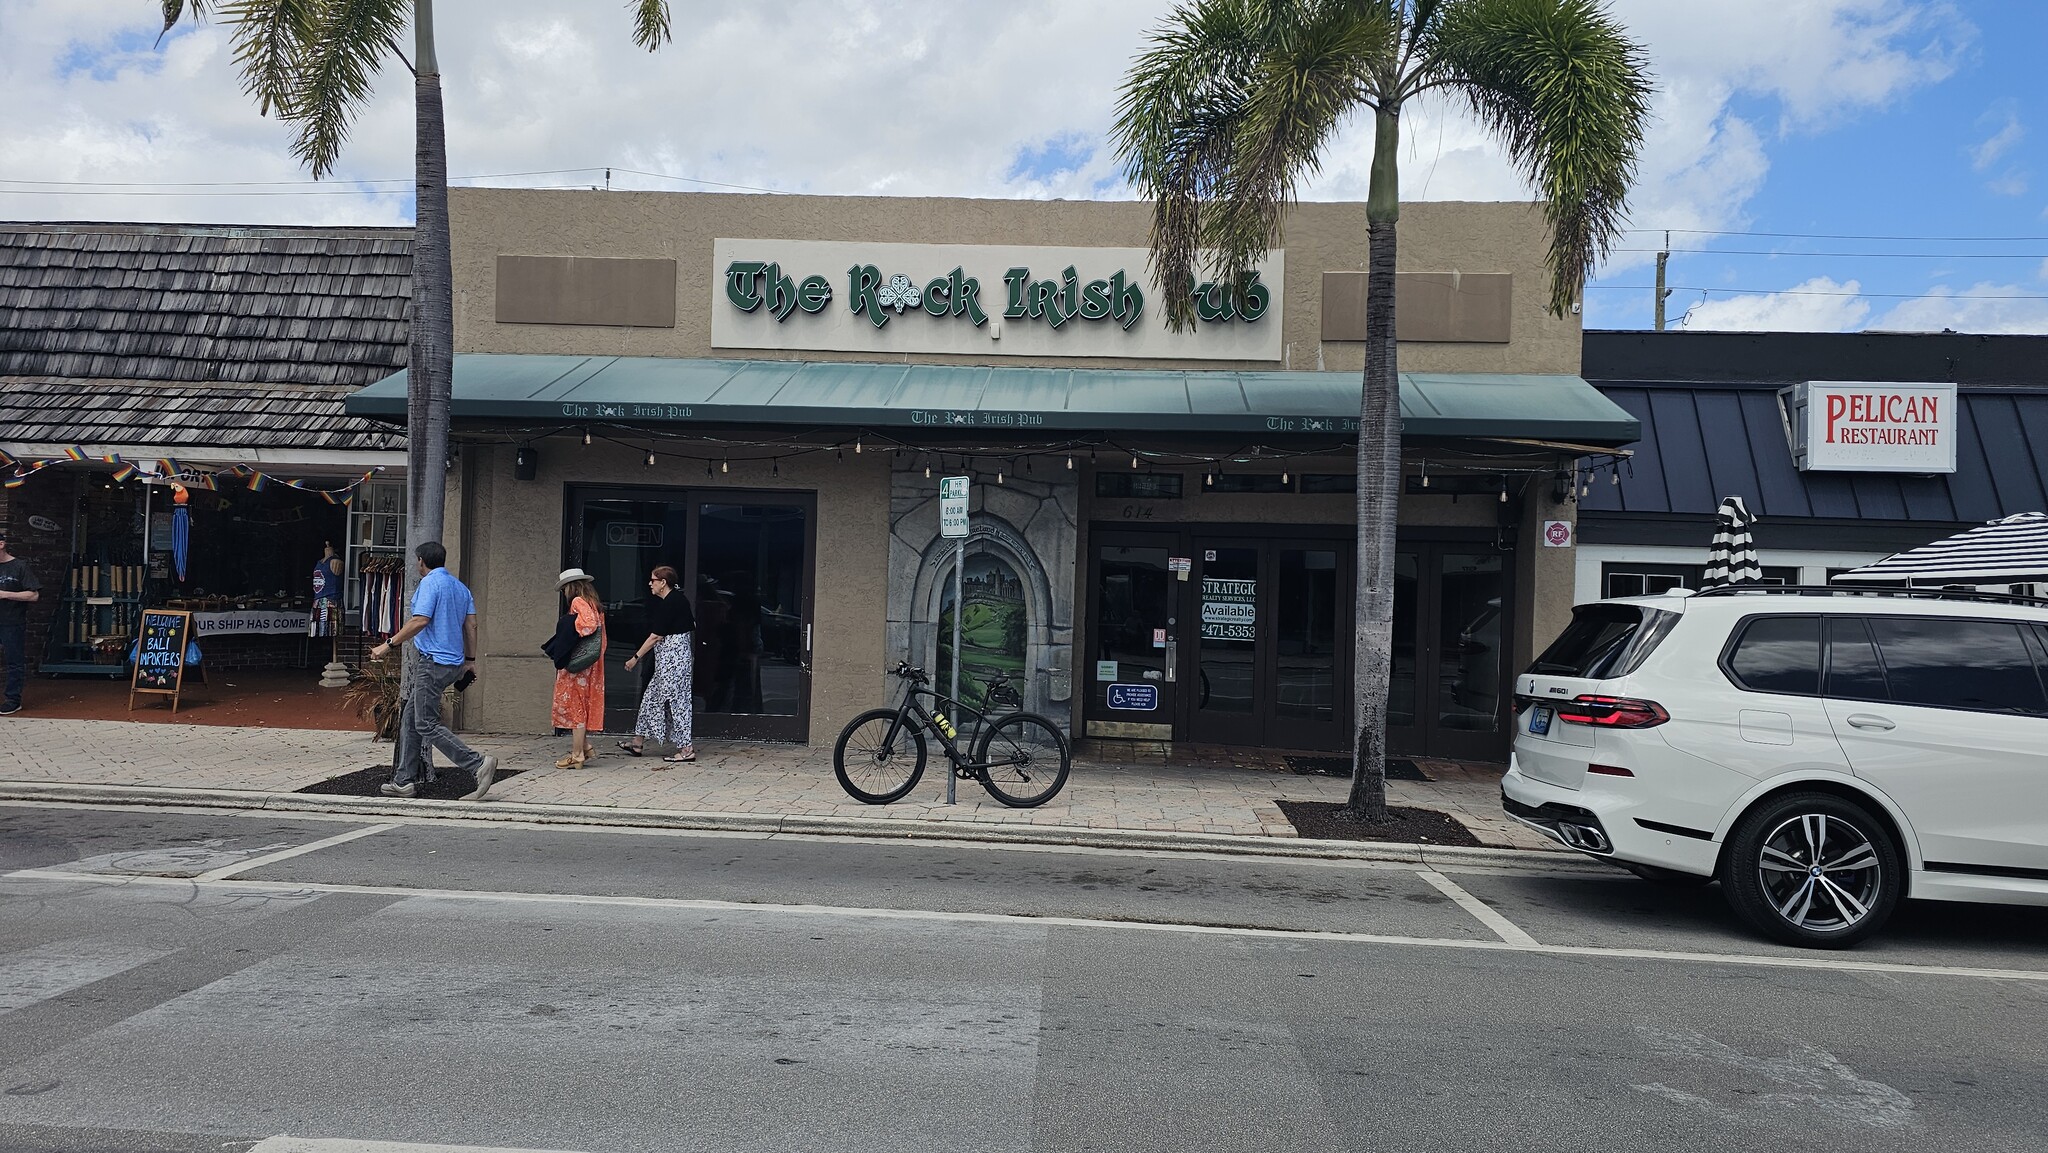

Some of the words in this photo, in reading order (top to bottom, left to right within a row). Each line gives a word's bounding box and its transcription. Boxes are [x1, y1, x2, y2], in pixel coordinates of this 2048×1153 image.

[726, 262, 832, 322] The
[1002, 264, 1145, 331] Irish
[1180, 269, 1271, 323] ub
[562, 403, 588, 417] The
[633, 404, 662, 417] Irish
[667, 405, 692, 418] Pub
[911, 410, 937, 425] The
[983, 412, 1012, 426] Irish
[1017, 412, 1042, 426] Pub
[1266, 416, 1294, 431] The
[1826, 394, 1938, 443] PELICAN
[1841, 427, 1938, 445] RESTAURANT
[941, 483, 950, 498] 4
[1122, 505, 1154, 520] 614
[609, 525, 661, 545] OPEN
[1552, 530, 1564, 538] RF
[1202, 581, 1256, 595] STRATEGIC
[1203, 605, 1254, 616] Available
[145, 614, 181, 628] WELCOME
[218, 619, 244, 630] SHIP
[247, 619, 270, 629] HAS
[273, 618, 305, 629] COME
[157, 627, 167, 637] TO
[1206, 624, 1256, 638] 471-5353
[147, 637, 170, 650] BALI
[140, 652, 180, 667] IMPORTERS
